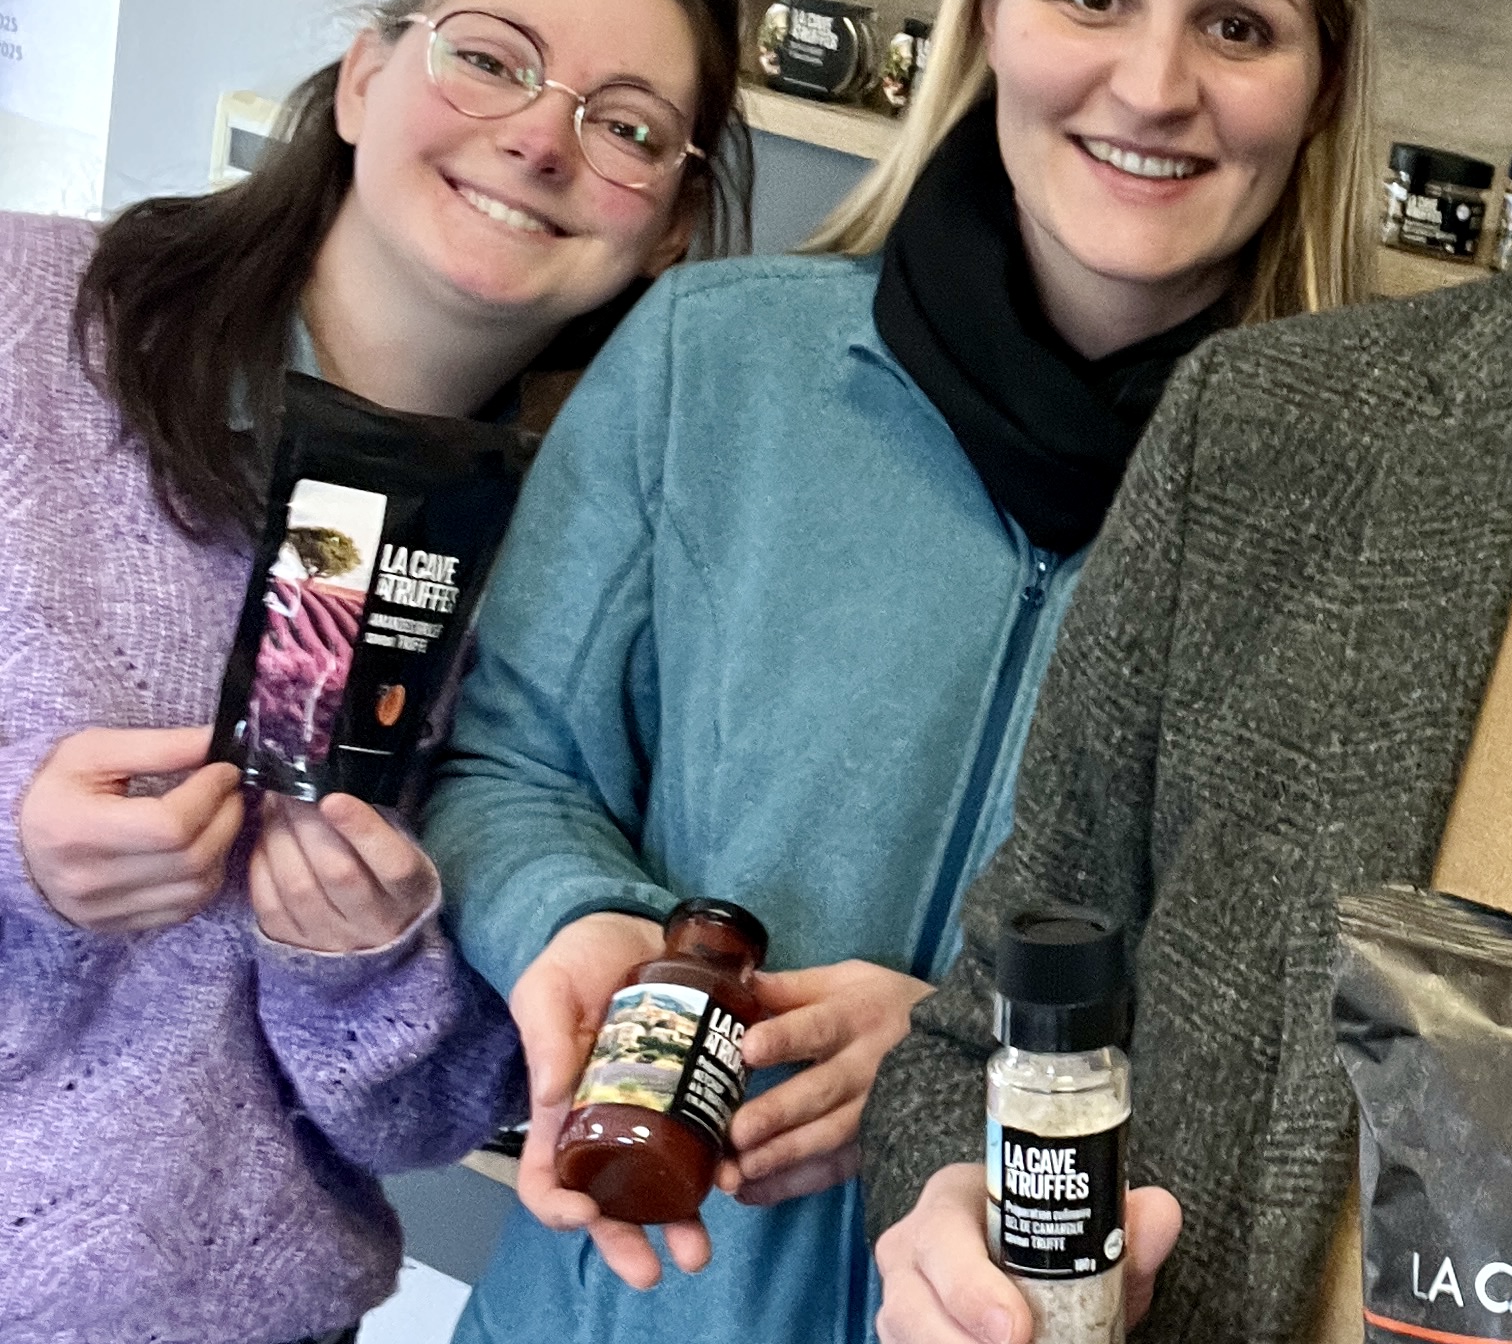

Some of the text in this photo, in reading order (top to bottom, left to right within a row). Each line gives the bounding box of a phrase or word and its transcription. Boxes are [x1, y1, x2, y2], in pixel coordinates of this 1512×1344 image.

[0, 40, 23, 61] 025
[380, 543, 460, 585] LA CAVE
[709, 1007, 733, 1038] LA
[1004, 1141, 1077, 1174] LA CAVE
[1411, 1252, 1465, 1308] LA
